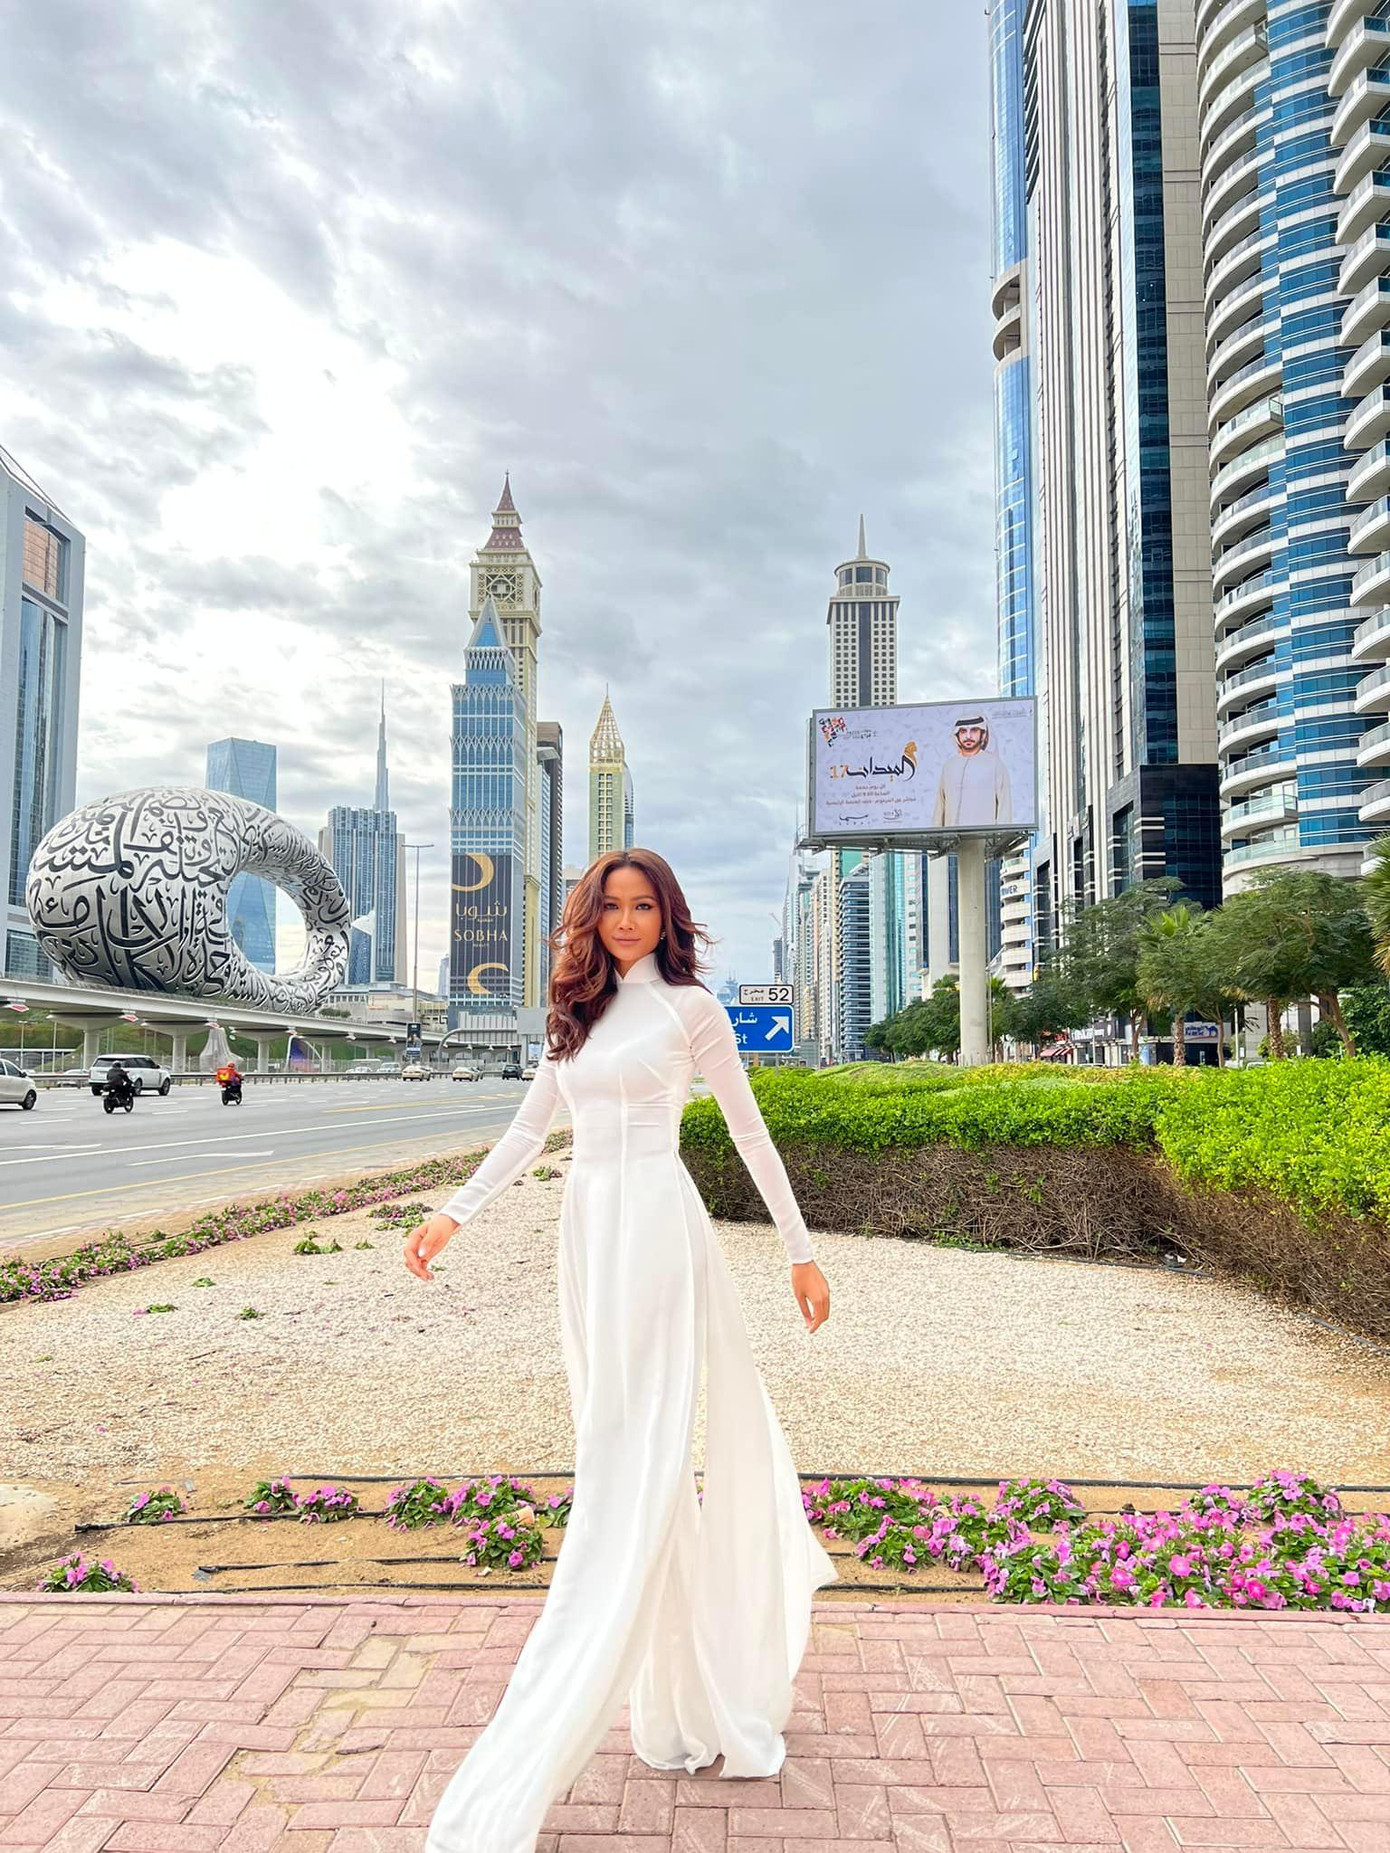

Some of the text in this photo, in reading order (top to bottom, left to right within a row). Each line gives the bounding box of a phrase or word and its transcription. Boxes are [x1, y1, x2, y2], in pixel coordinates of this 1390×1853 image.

[454, 929, 508, 942] SOBHA
[768, 987, 790, 1002] 52
[731, 1012, 758, 1027] شار
